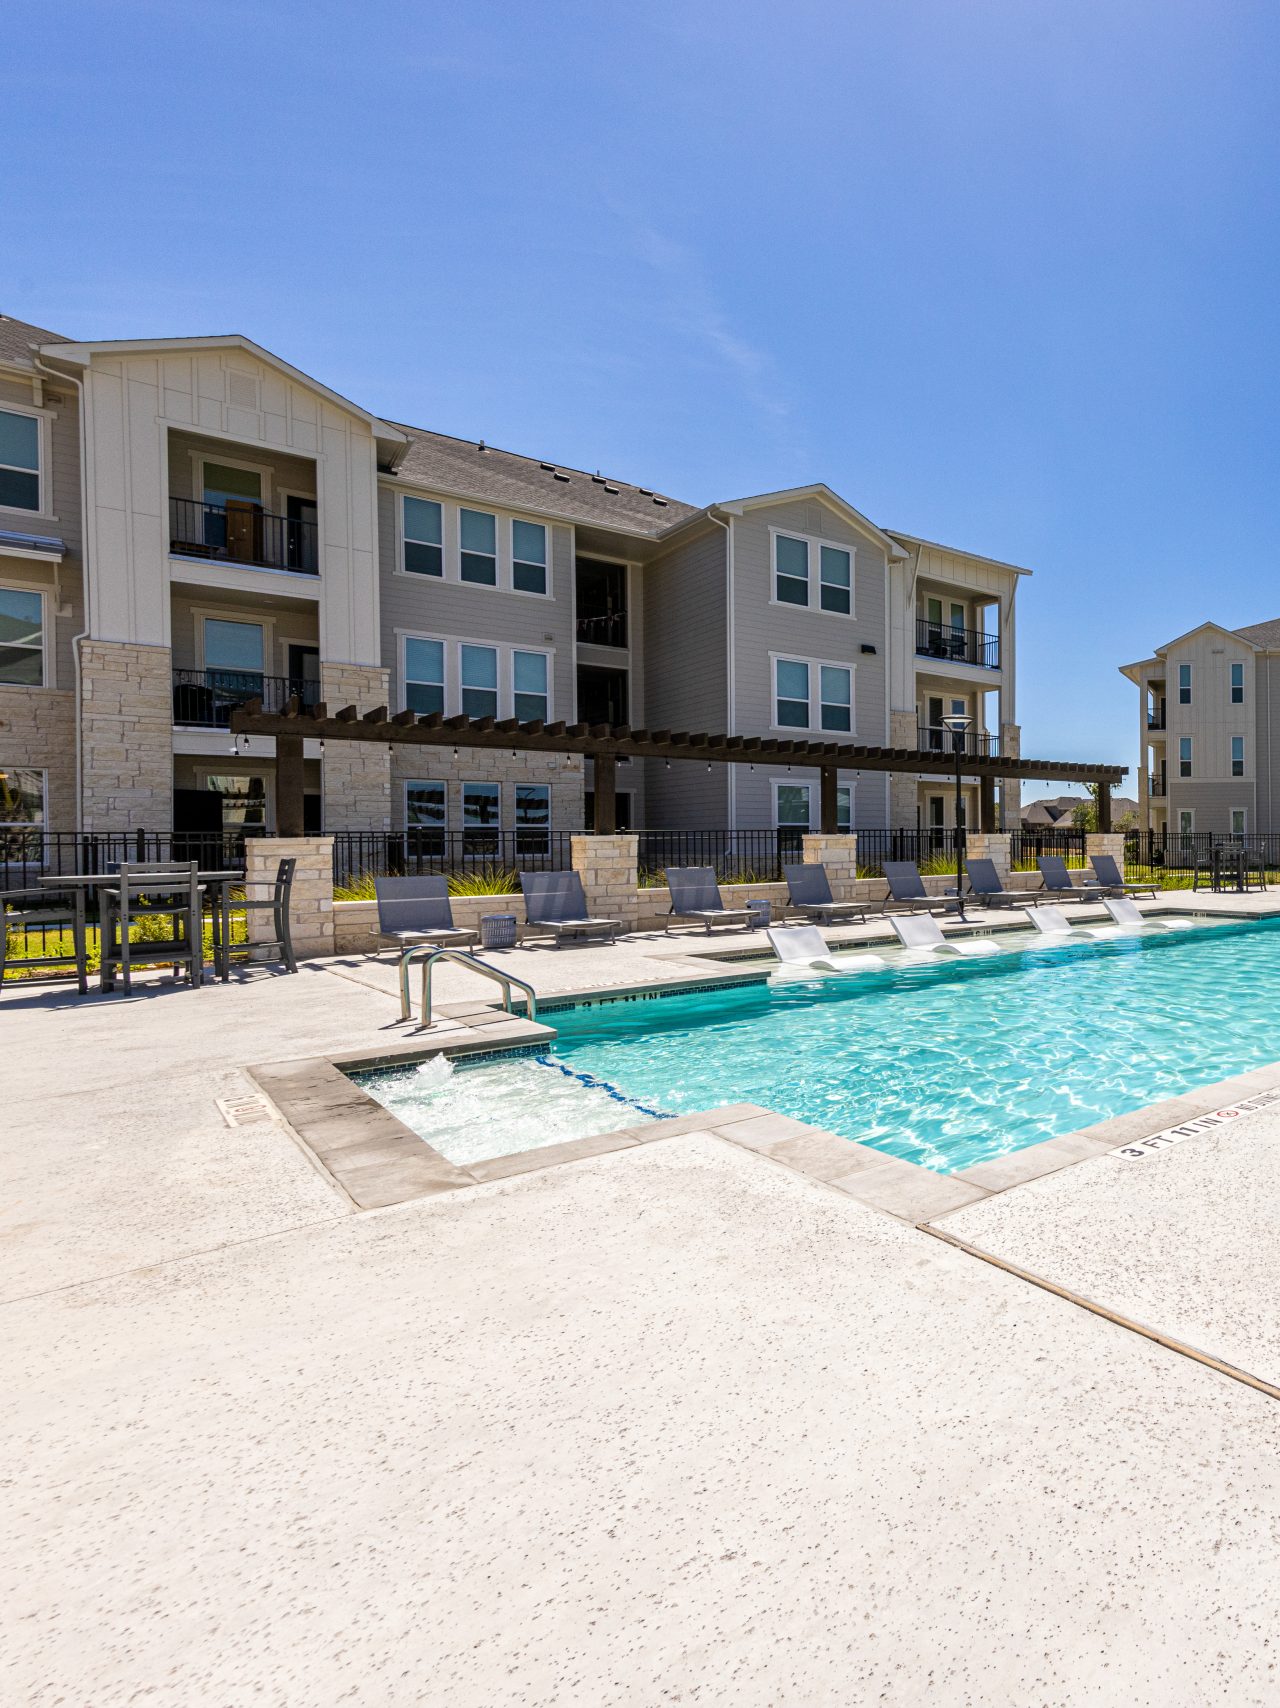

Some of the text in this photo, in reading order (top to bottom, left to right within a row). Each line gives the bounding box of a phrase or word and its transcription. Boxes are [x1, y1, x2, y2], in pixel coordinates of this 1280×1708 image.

[643, 992, 657, 1000] IN
[1121, 1148, 1145, 1157] 3
[1141, 1135, 1173, 1149] FT
[1171, 1126, 1200, 1137] 11
[1193, 1117, 1224, 1129] IN
